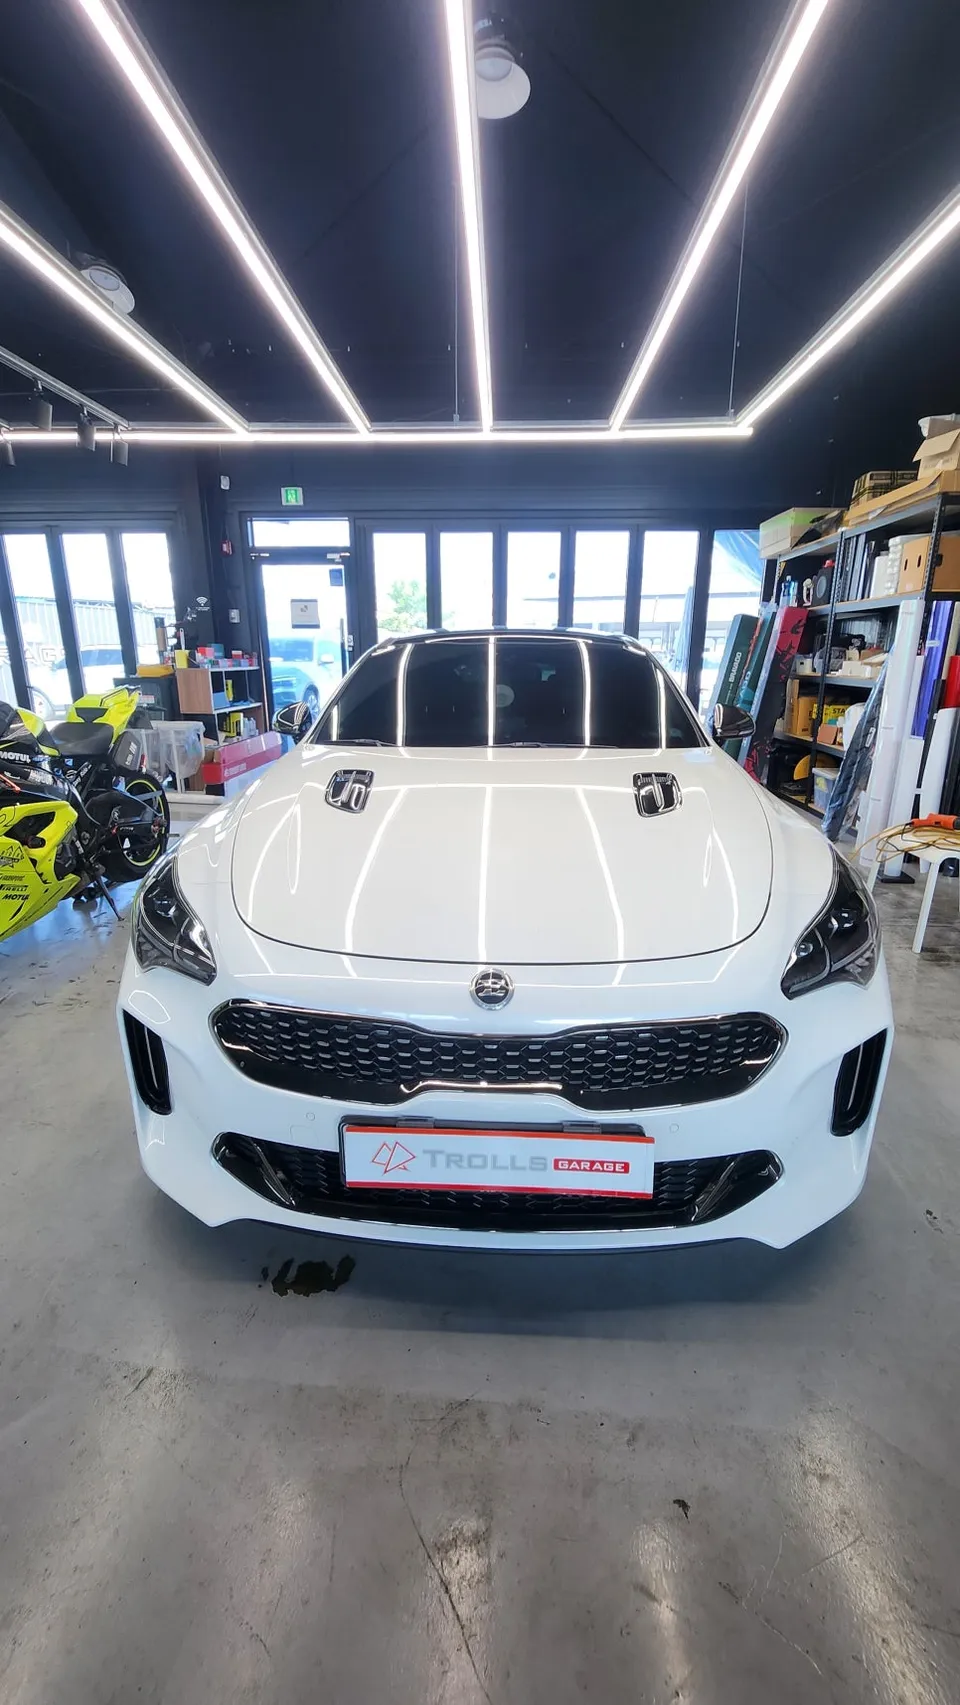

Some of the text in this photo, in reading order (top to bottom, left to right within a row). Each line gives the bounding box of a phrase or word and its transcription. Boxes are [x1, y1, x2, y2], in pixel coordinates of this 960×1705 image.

[729, 651, 742, 683] BRAVADO
[0, 751, 31, 763] MOTUL
[423, 1149, 626, 1172] TROLLS GARAGE
